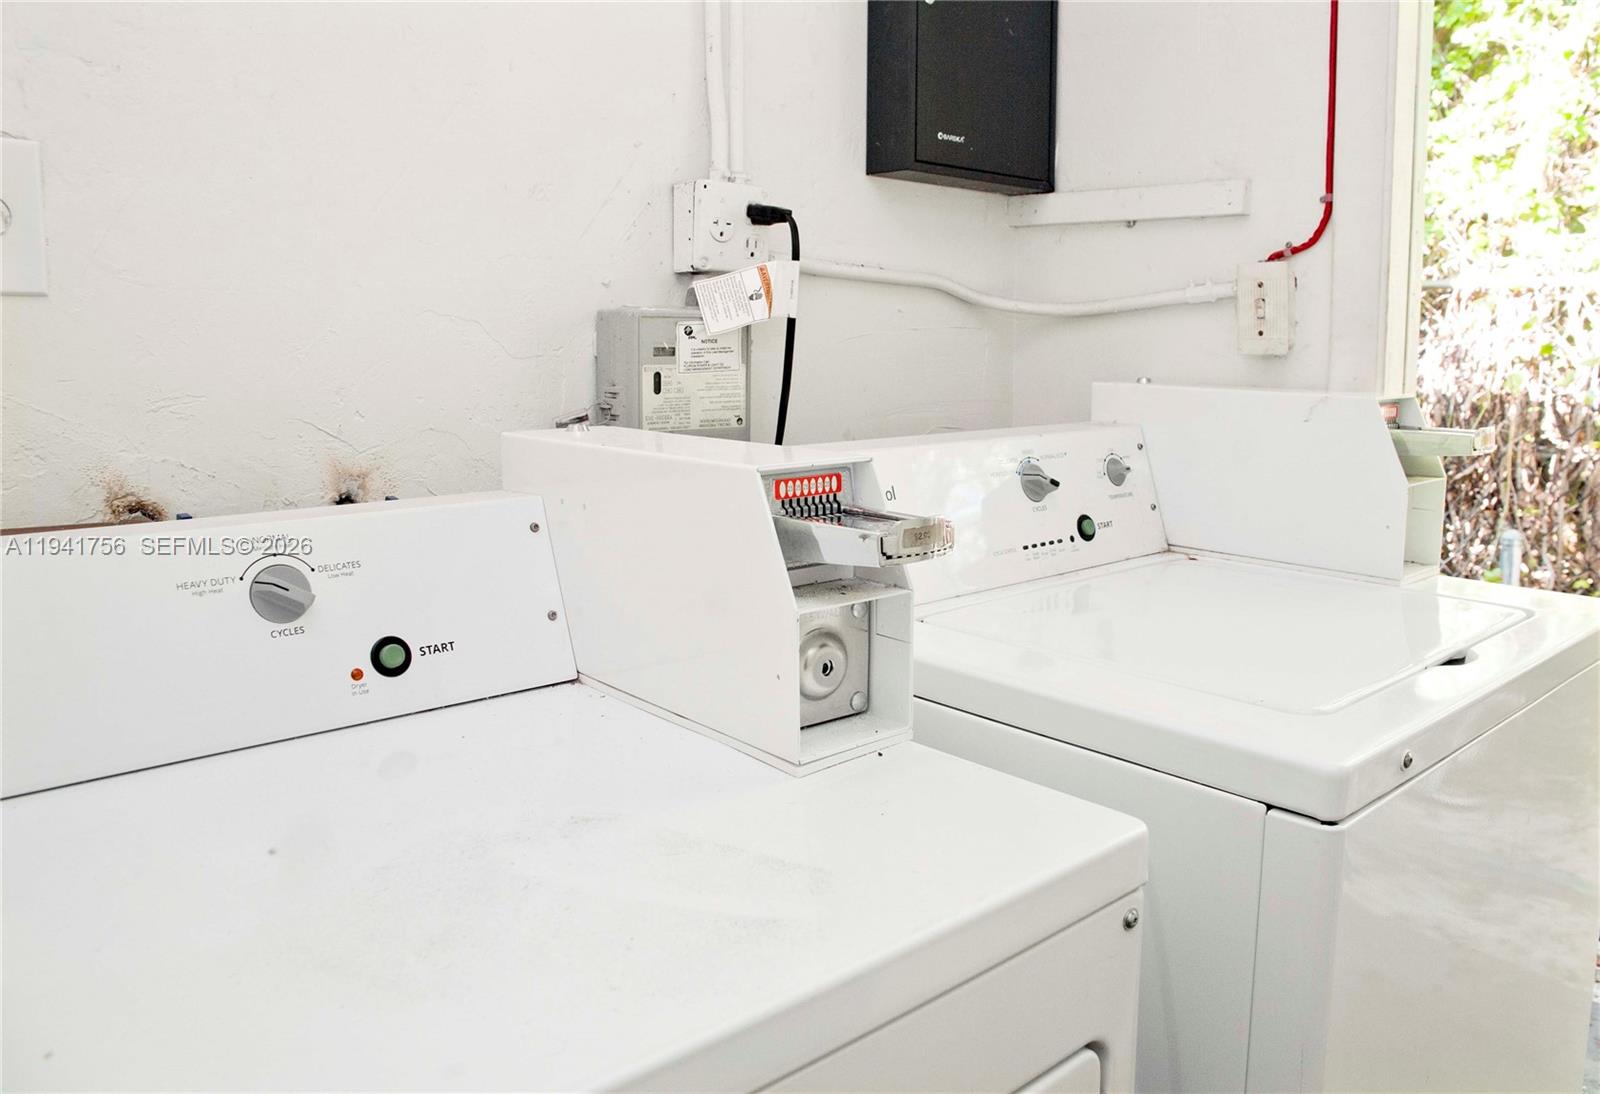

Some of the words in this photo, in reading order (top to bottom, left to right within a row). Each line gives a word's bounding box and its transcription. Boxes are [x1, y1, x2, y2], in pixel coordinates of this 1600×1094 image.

[1097, 521, 1113, 530] START
[317, 560, 362, 573] DELICATES
[176, 579, 208, 591] HEAVY
[210, 576, 236, 588] DUTY
[270, 625, 305, 639] CYCLES
[419, 641, 455, 657] START
